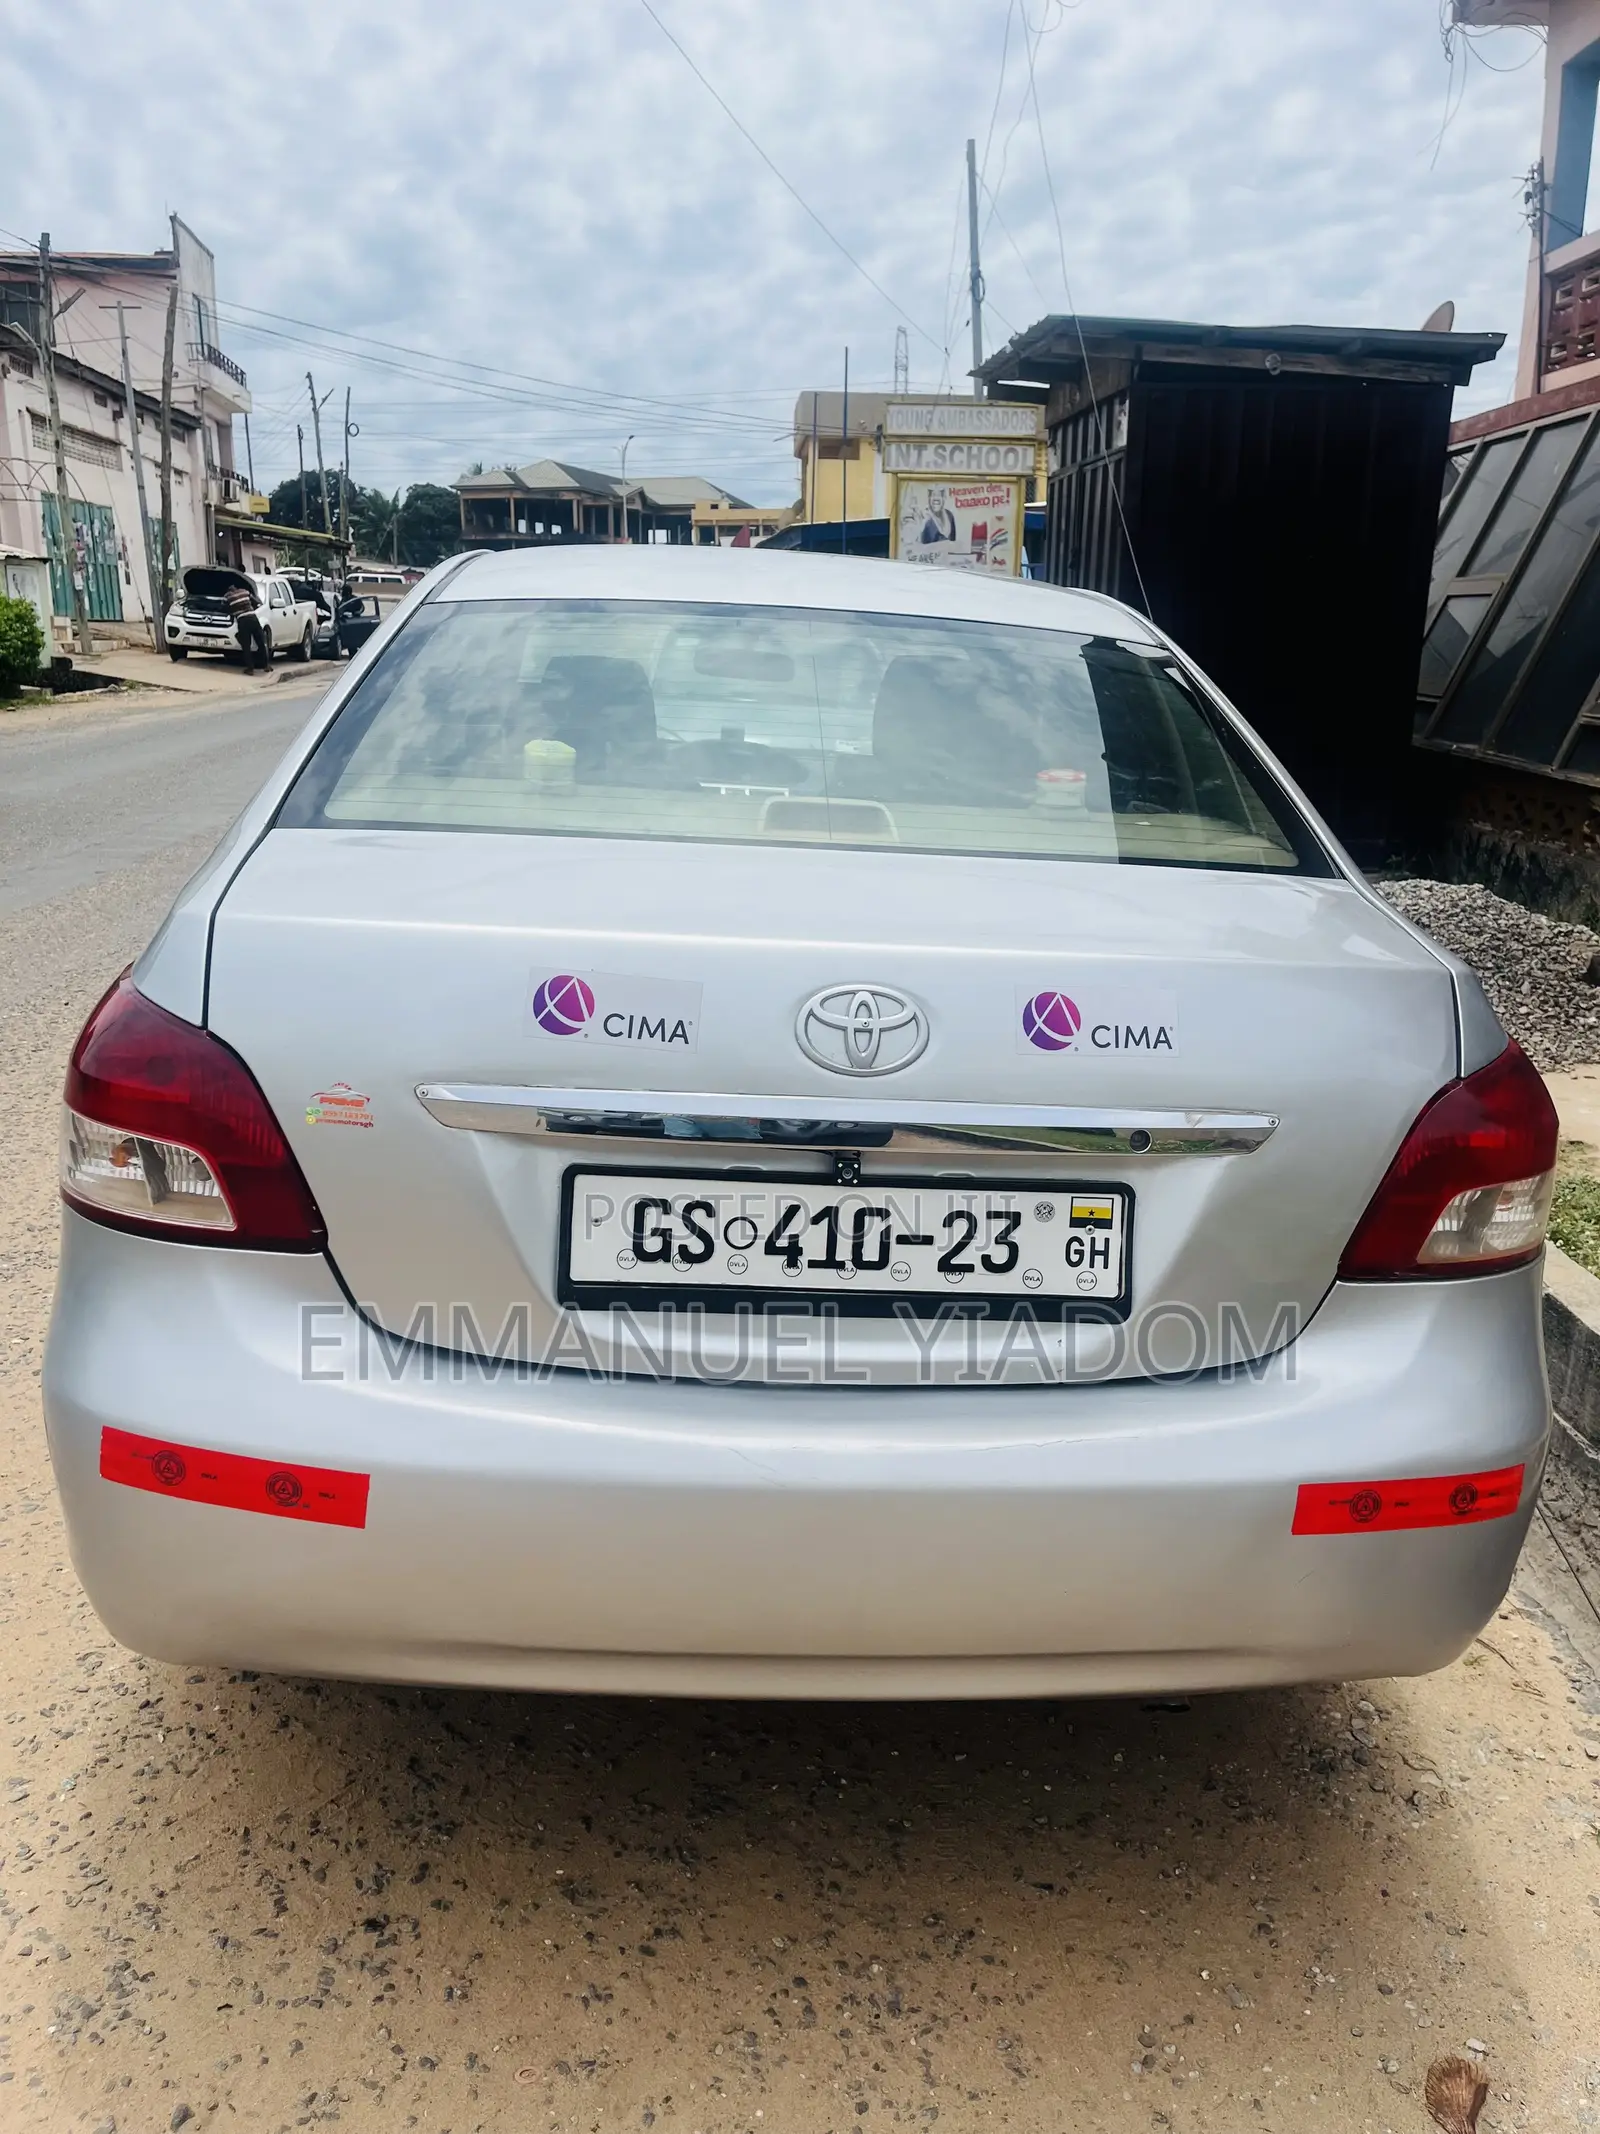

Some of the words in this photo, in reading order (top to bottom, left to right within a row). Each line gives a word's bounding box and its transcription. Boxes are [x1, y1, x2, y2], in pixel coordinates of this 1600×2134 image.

[889, 408, 933, 432] YOUNG
[938, 409, 1038, 431] AMBASSADORS
[634, 1198, 716, 1264] GS
[1065, 1235, 1110, 1269] GH
